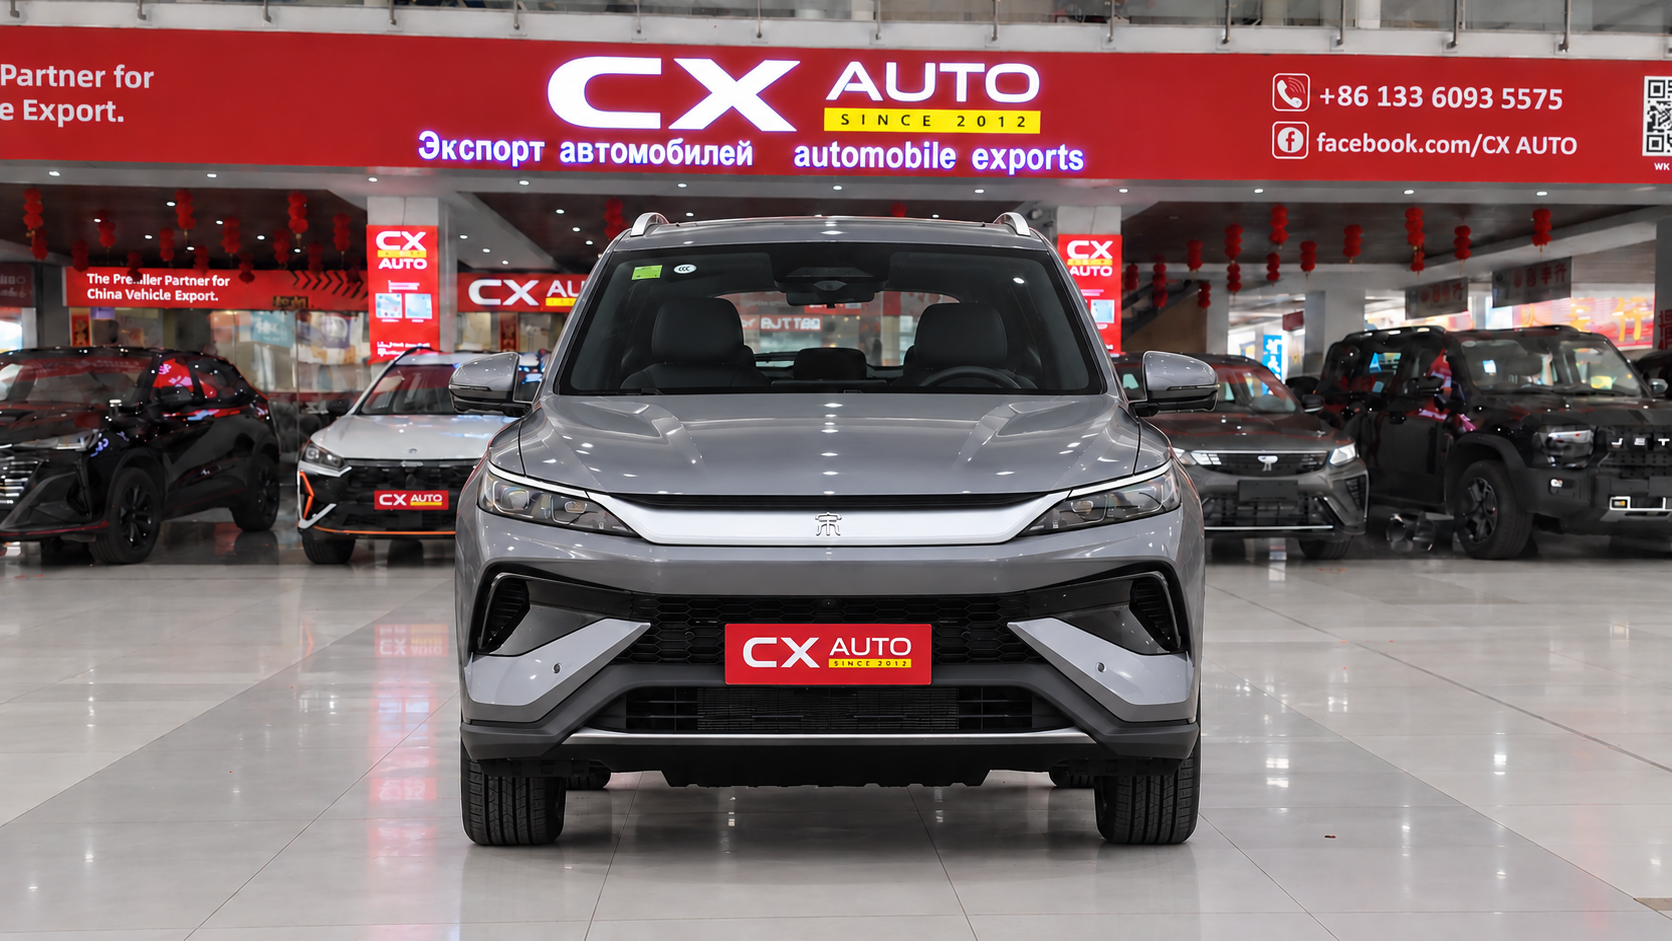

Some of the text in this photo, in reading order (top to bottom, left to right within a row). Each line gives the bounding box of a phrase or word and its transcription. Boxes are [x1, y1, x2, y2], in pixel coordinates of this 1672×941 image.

[1, 64, 154, 88] Partner for
[826, 61, 1039, 103] AUTO
[548, 56, 800, 131] CX
[1320, 86, 1562, 110] +86 133 6093 5575
[24, 100, 123, 127] Export.
[841, 114, 1025, 127] SINCE 2012
[418, 130, 752, 168] Экспорт автомобилей
[1317, 132, 1577, 157] facebook.com/CX AUTO
[794, 141, 1083, 175] automobile exports
[376, 231, 426, 250] CX
[1067, 240, 1113, 259] CX
[378, 258, 427, 269] AUTO
[1078, 266, 1113, 277] AUTO
[87, 273, 109, 284] The
[165, 276, 210, 286] Partner
[212, 275, 230, 286] for
[87, 288, 218, 303] China Vehicle Export.
[468, 279, 540, 305] CX
[547, 280, 585, 297] AU
[379, 494, 442, 505] CX AUTO
[743, 637, 911, 668] CX AUTO
